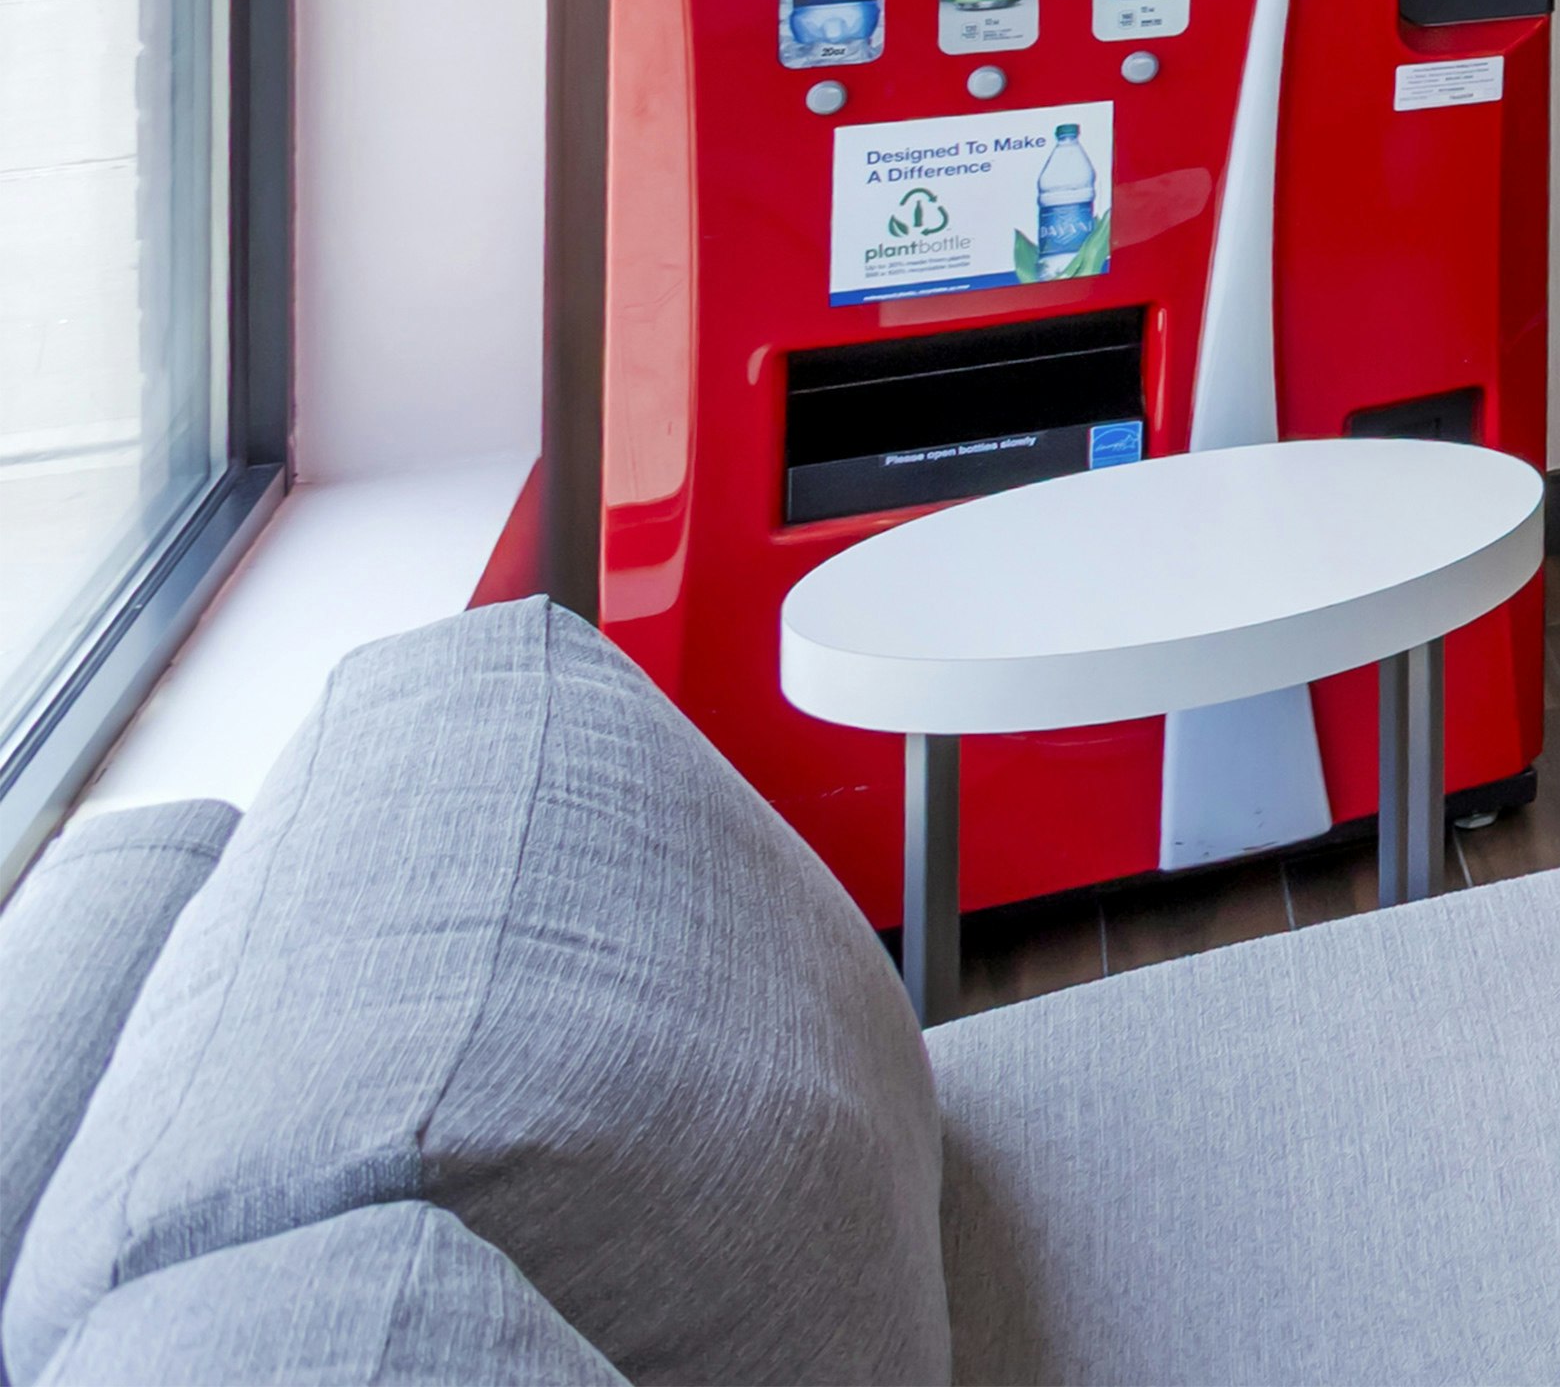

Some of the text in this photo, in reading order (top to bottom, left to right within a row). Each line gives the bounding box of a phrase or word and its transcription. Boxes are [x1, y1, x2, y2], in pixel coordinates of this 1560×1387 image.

[867, 135, 1046, 165] Designed To Make
[866, 160, 992, 184] A Difference
[865, 234, 972, 264] plantbottle
[884, 435, 1037, 467] Please open bottles slowly
